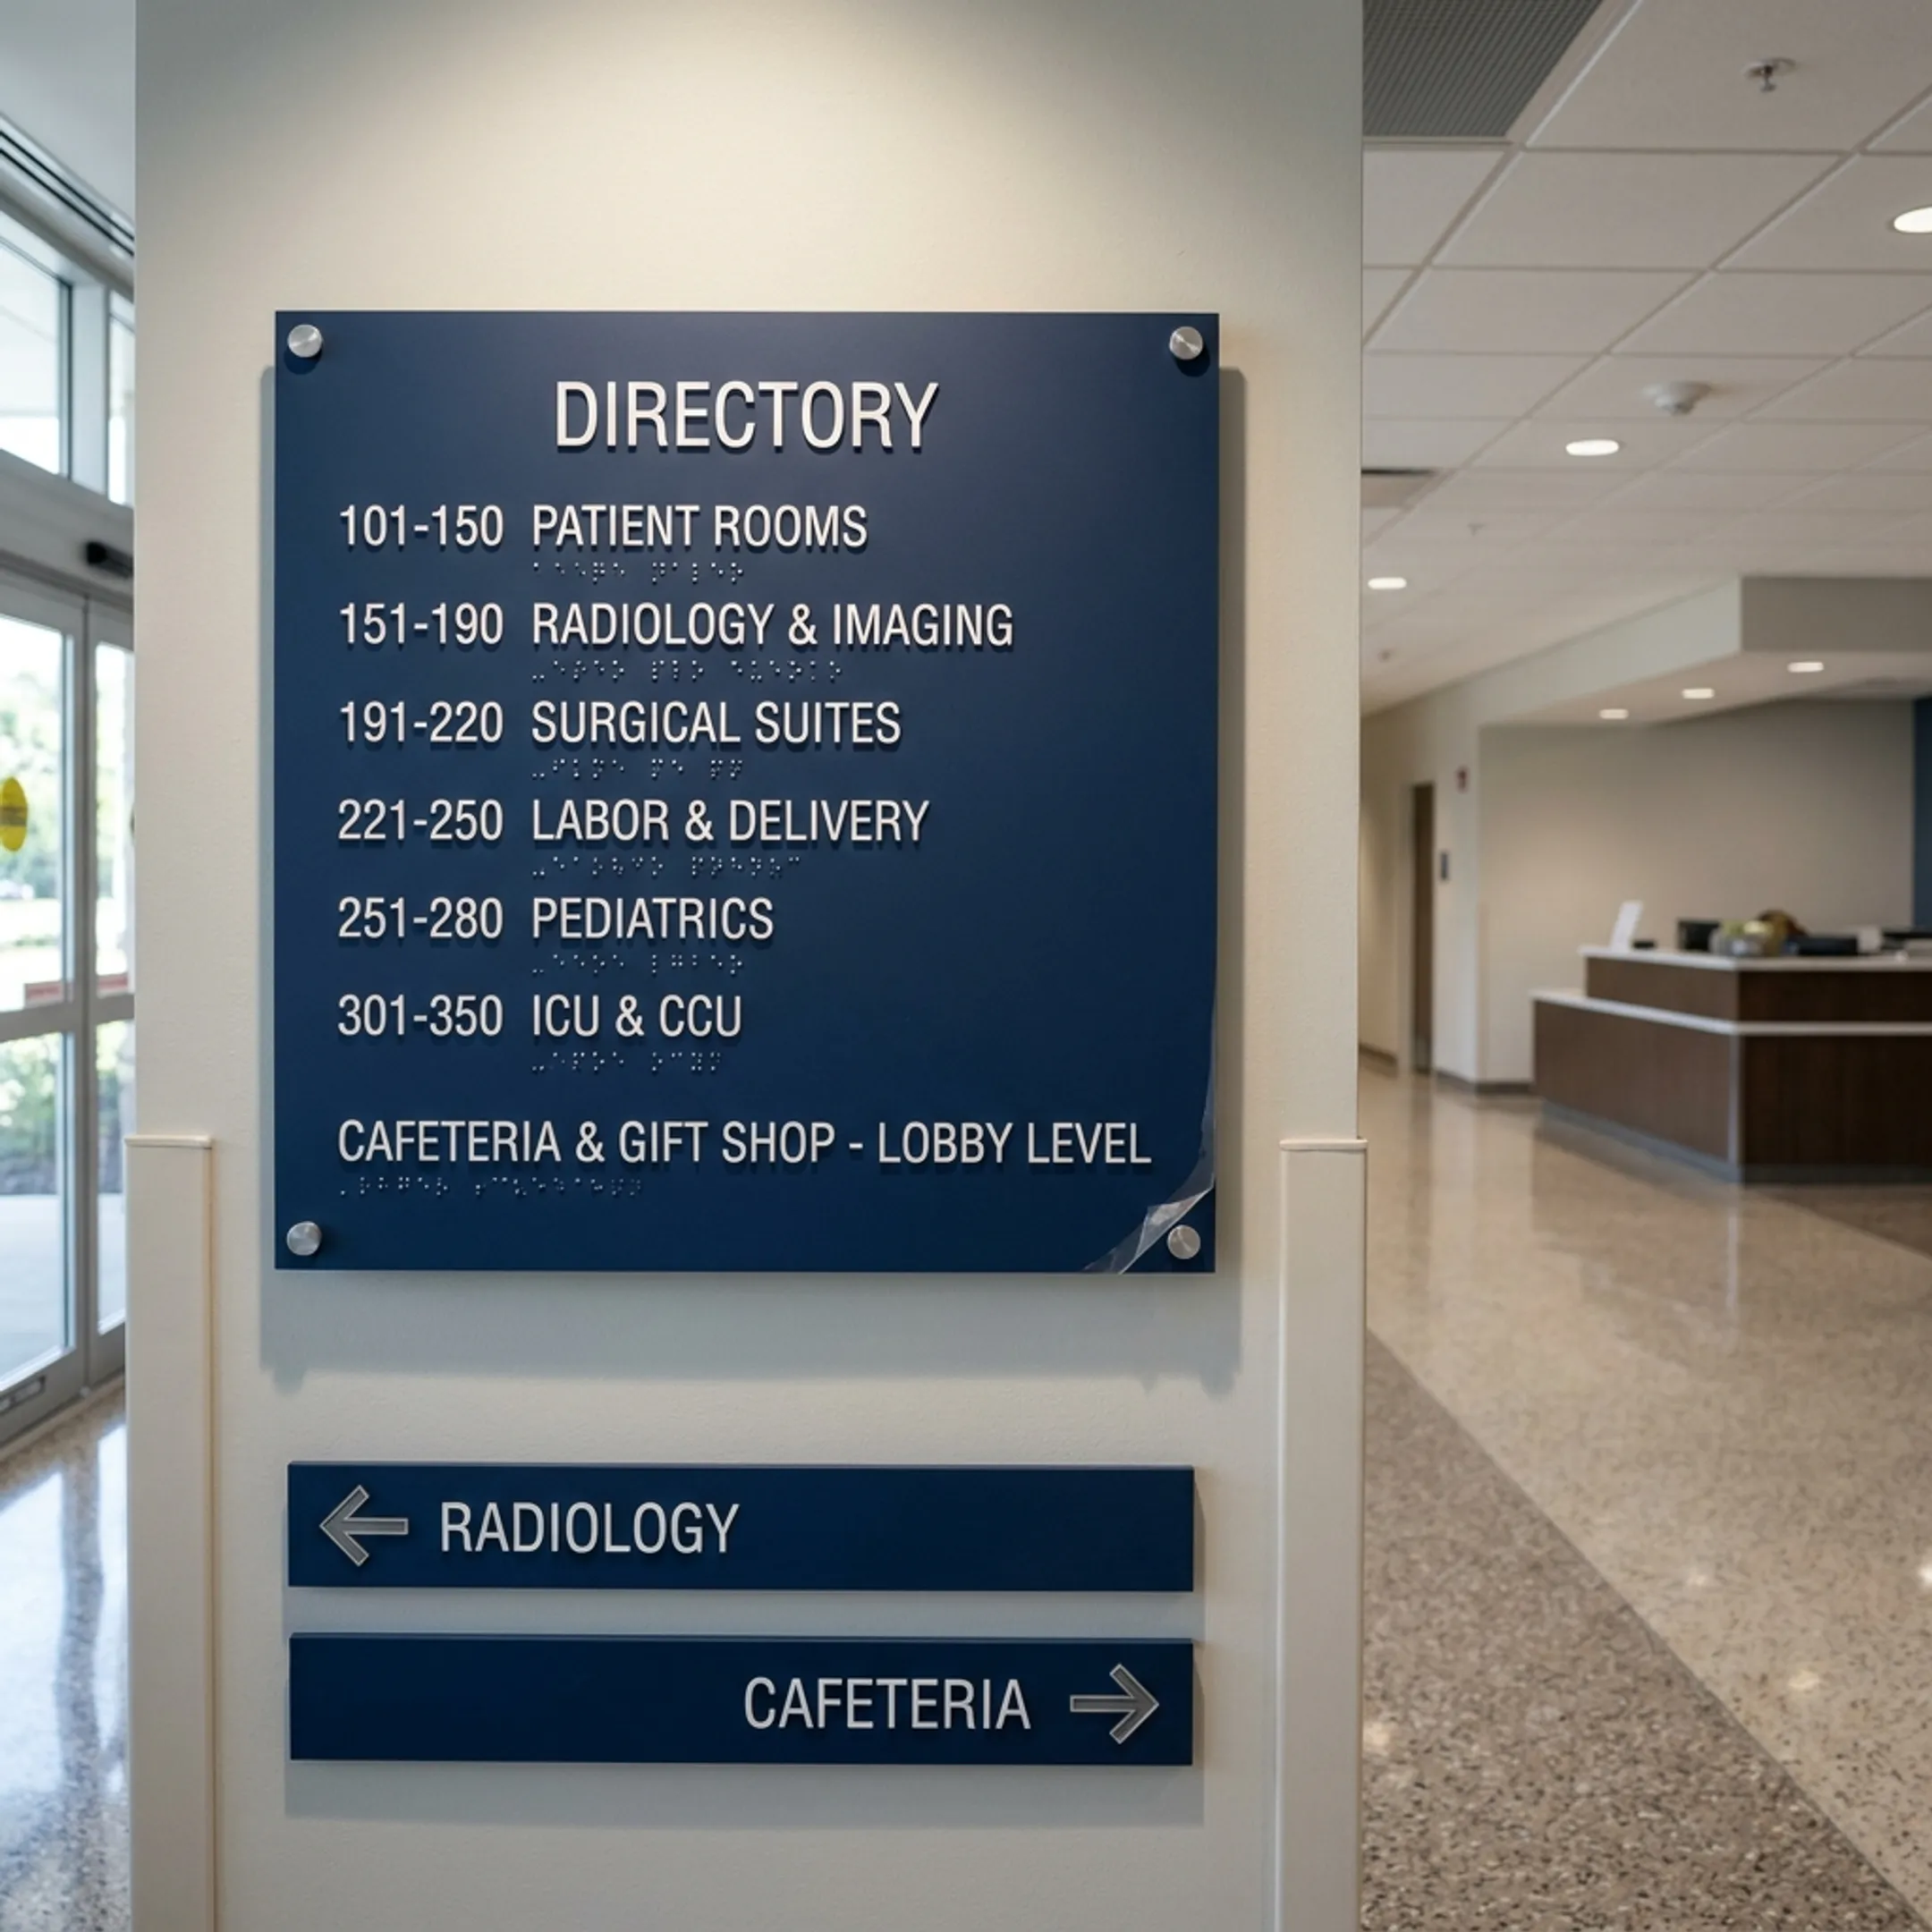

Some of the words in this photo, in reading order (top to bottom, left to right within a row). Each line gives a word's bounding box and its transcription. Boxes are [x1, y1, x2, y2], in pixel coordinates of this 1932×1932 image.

[556, 379, 939, 449] DIRECTORY
[340, 504, 504, 547] 101-150
[532, 504, 700, 547] PATIENT
[715, 504, 868, 547] ROOMS
[340, 602, 504, 645] 151-190
[532, 602, 775, 646] RADIOLOGY
[788, 603, 818, 646] &
[833, 603, 1013, 647] IMAGING
[340, 700, 504, 743] 191-220
[531, 699, 741, 743] SURGICAL
[755, 700, 901, 744] SUITES
[338, 799, 503, 841] 221-250
[532, 798, 669, 841] LABOR
[684, 800, 714, 842] &
[729, 800, 929, 842] DELIVERY
[338, 896, 503, 938] 251-280
[532, 897, 774, 939] PEDIATRICS
[338, 994, 503, 1037] 301-350
[532, 994, 599, 1037] ICU
[615, 995, 645, 1037] &
[659, 994, 741, 1037] CCU
[338, 1119, 562, 1163] CAFETERIA
[575, 1121, 605, 1163] &
[619, 1120, 708, 1163] GIFT
[722, 1121, 835, 1164] SHOP
[878, 1121, 1013, 1164] LOBBY
[1028, 1123, 1152, 1165] LEVEL
[441, 1502, 739, 1555] RADIOLOGY
[744, 1677, 1030, 1730] CAFETERIA
